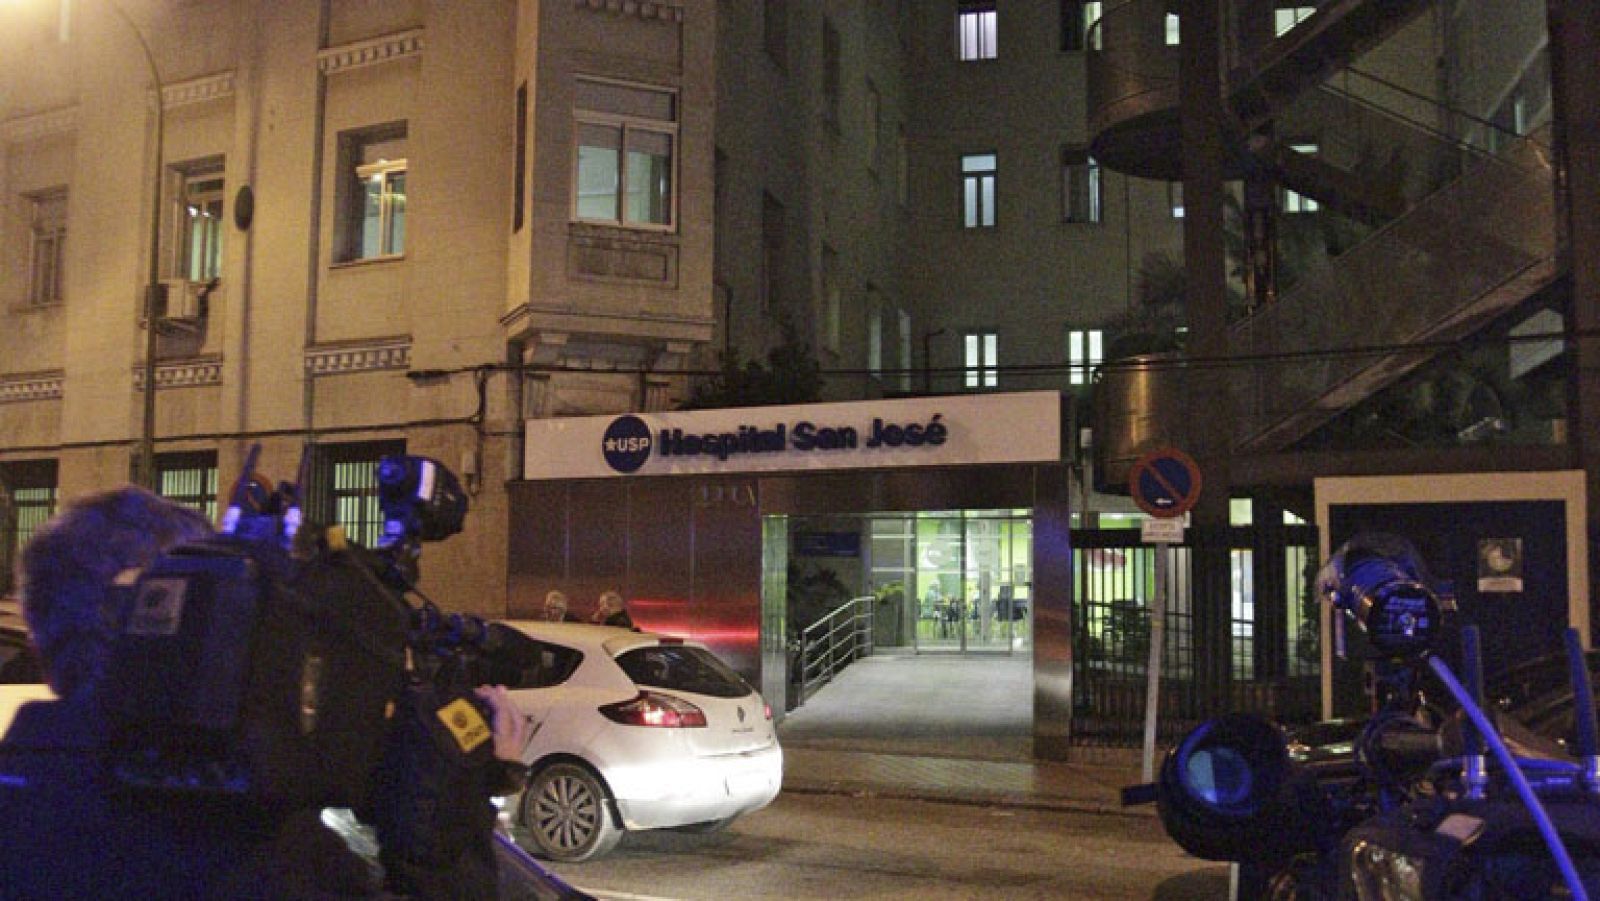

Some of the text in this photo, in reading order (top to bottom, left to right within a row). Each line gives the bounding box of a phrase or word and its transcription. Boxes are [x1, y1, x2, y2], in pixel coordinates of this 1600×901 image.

[618, 437, 649, 452] USP
[660, 413, 947, 461] Hospital San José
